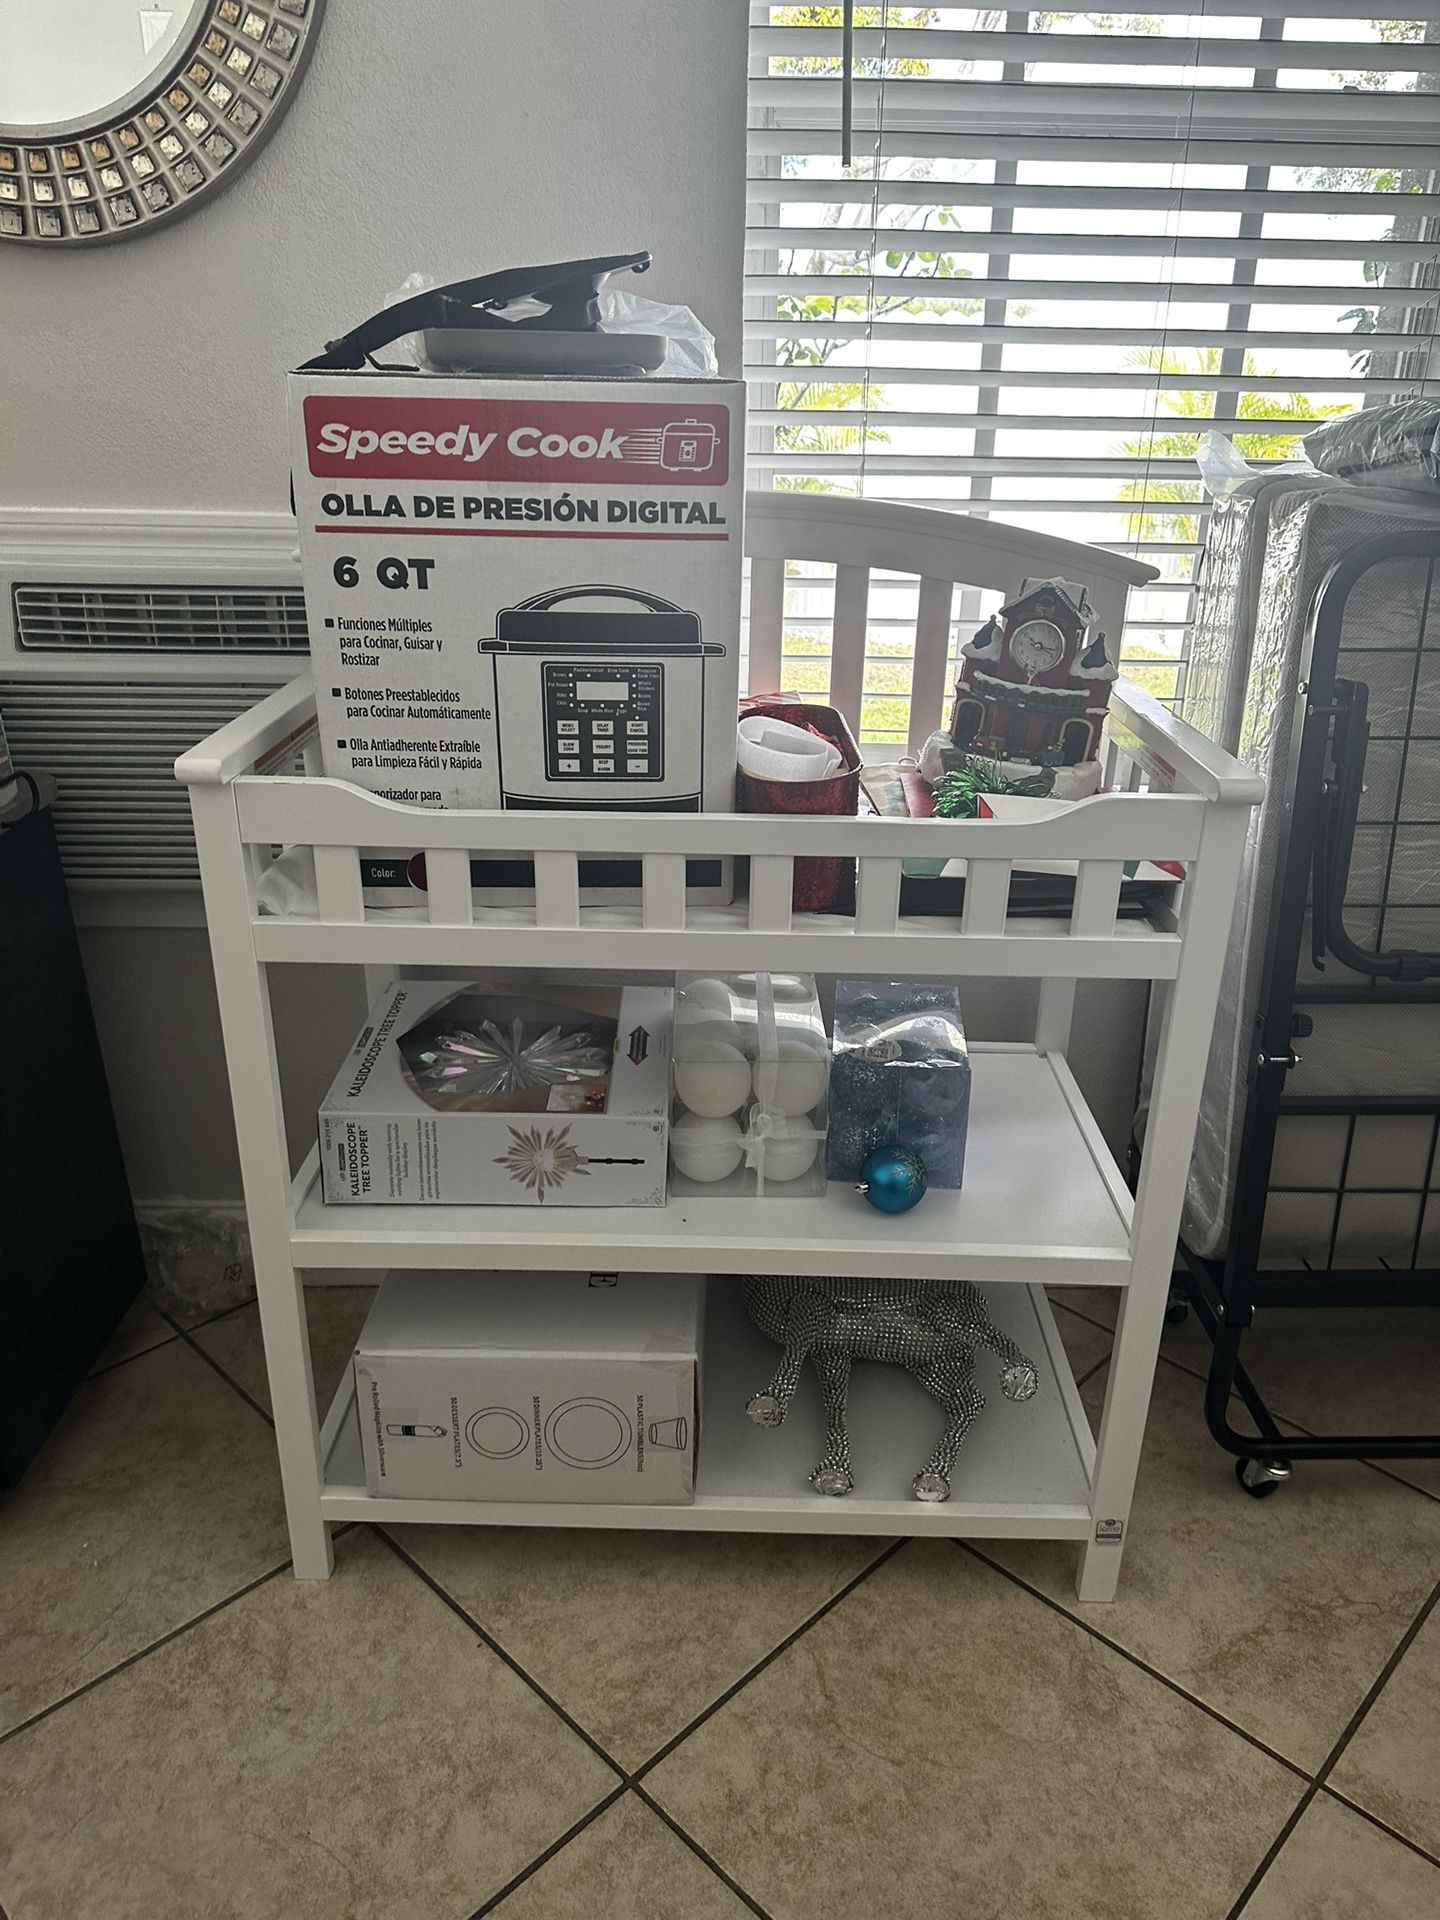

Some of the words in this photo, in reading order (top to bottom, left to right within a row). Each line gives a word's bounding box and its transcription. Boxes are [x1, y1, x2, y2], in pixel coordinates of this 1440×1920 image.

[316, 423, 498, 462] Speedy
[507, 427, 629, 460] Cook
[321, 494, 406, 517] OLLA
[414, 495, 455, 519] DE
[464, 492, 600, 522] PRESIÓN
[607, 501, 726, 524] DIGITAL
[333, 556, 359, 588] 6
[376, 558, 435, 590] QT
[338, 617, 386, 631] Funciones
[388, 618, 432, 634] Múltiples
[340, 637, 361, 649] para
[364, 636, 402, 651] Cocinar,
[404, 637, 433, 650] Guisar
[437, 640, 442, 652] y
[342, 653, 380, 666] Rostizar
[345, 687, 384, 700] Botones
[386, 689, 460, 702] Preestablecidos
[347, 706, 368, 719] para
[371, 705, 405, 717] Cocinar
[407, 706, 491, 720] Automáticamente
[350, 738, 369, 751] Olla
[371, 739, 437, 752] Antiadherente
[439, 740, 481, 753] Extraíble
[352, 757, 373, 769] para
[375, 755, 417, 770] Limpieza
[419, 756, 440, 768] Fácil
[442, 758, 447, 770] y
[450, 756, 482, 771] Rápida
[420, 791, 442, 802] para
[346, 1036, 387, 1098] KALEIDOSCOPE
[376, 1019, 396, 1037] TREE
[347, 1122, 360, 1197] KALEIDOSCOPE
[361, 1169, 372, 1193] TREE
